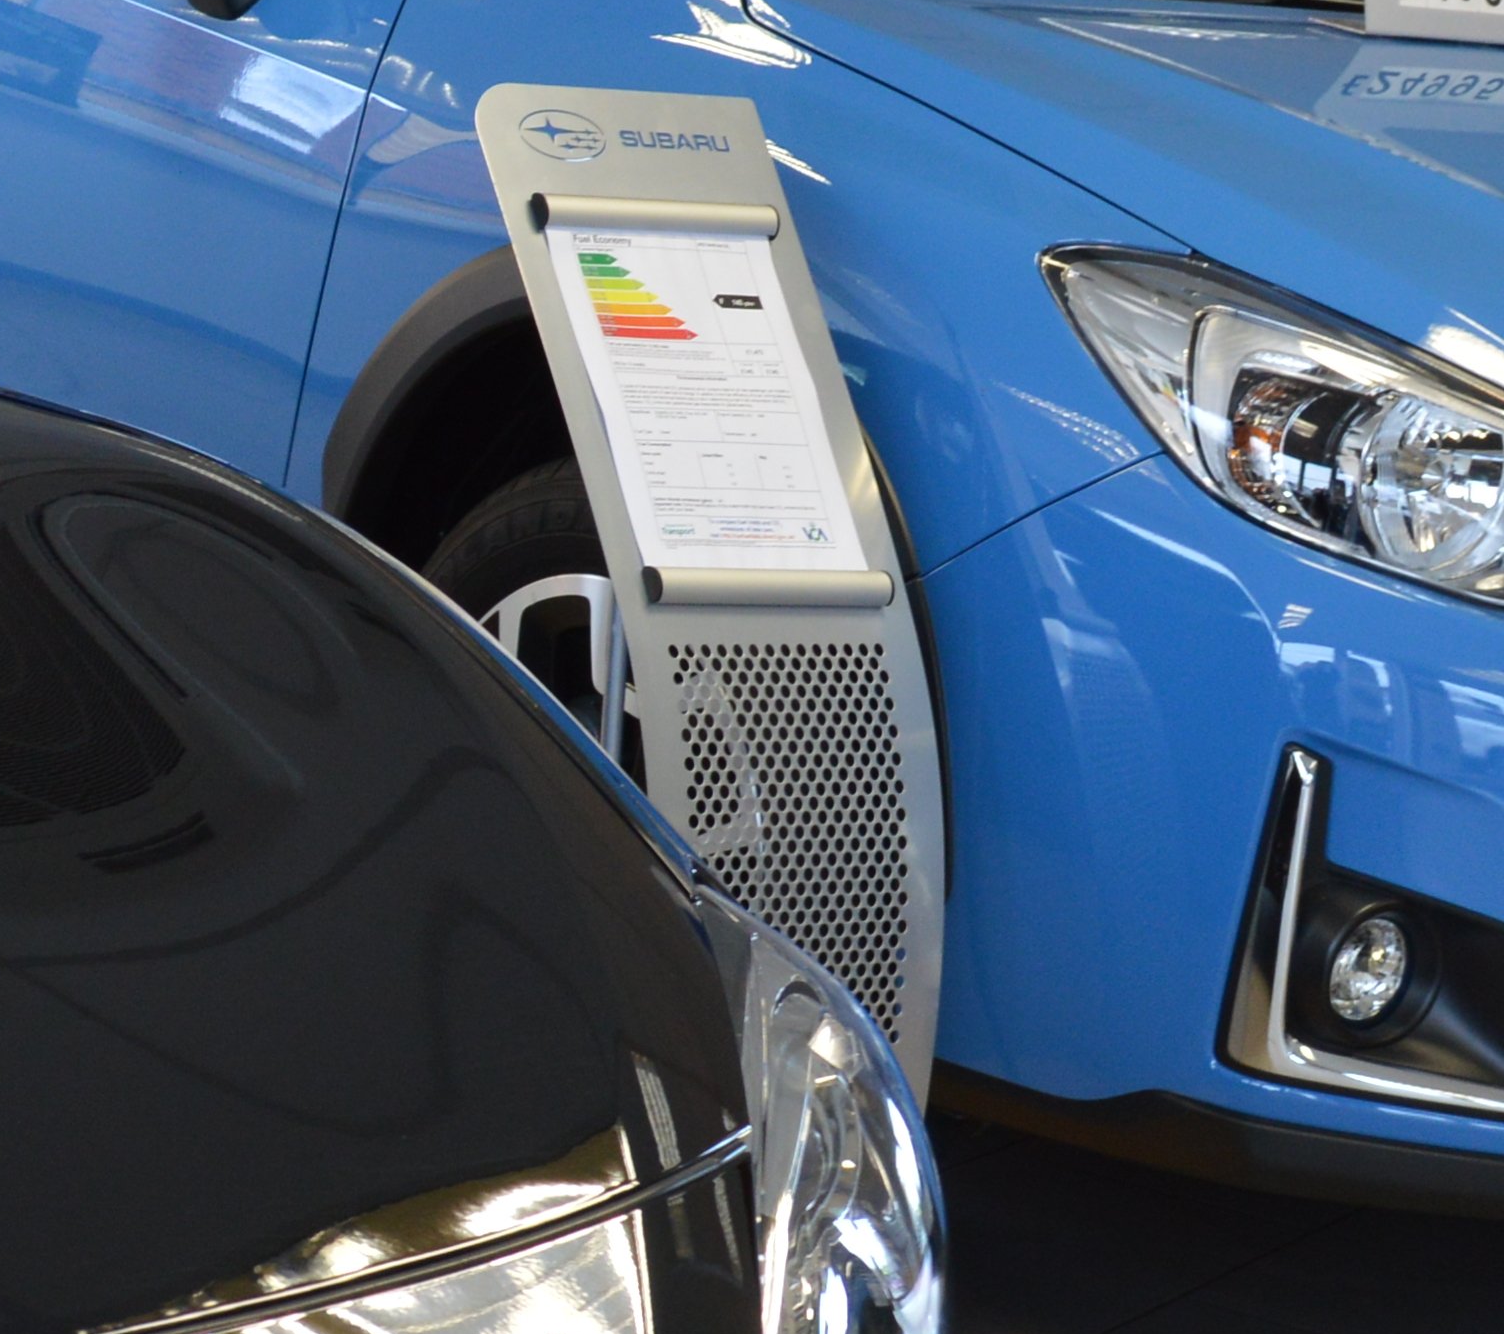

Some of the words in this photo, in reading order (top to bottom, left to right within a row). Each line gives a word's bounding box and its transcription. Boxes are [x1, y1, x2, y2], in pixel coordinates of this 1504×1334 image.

[618, 129, 731, 154] SUBARU
[573, 233, 592, 244] Fuel
[592, 235, 632, 247] Economy
